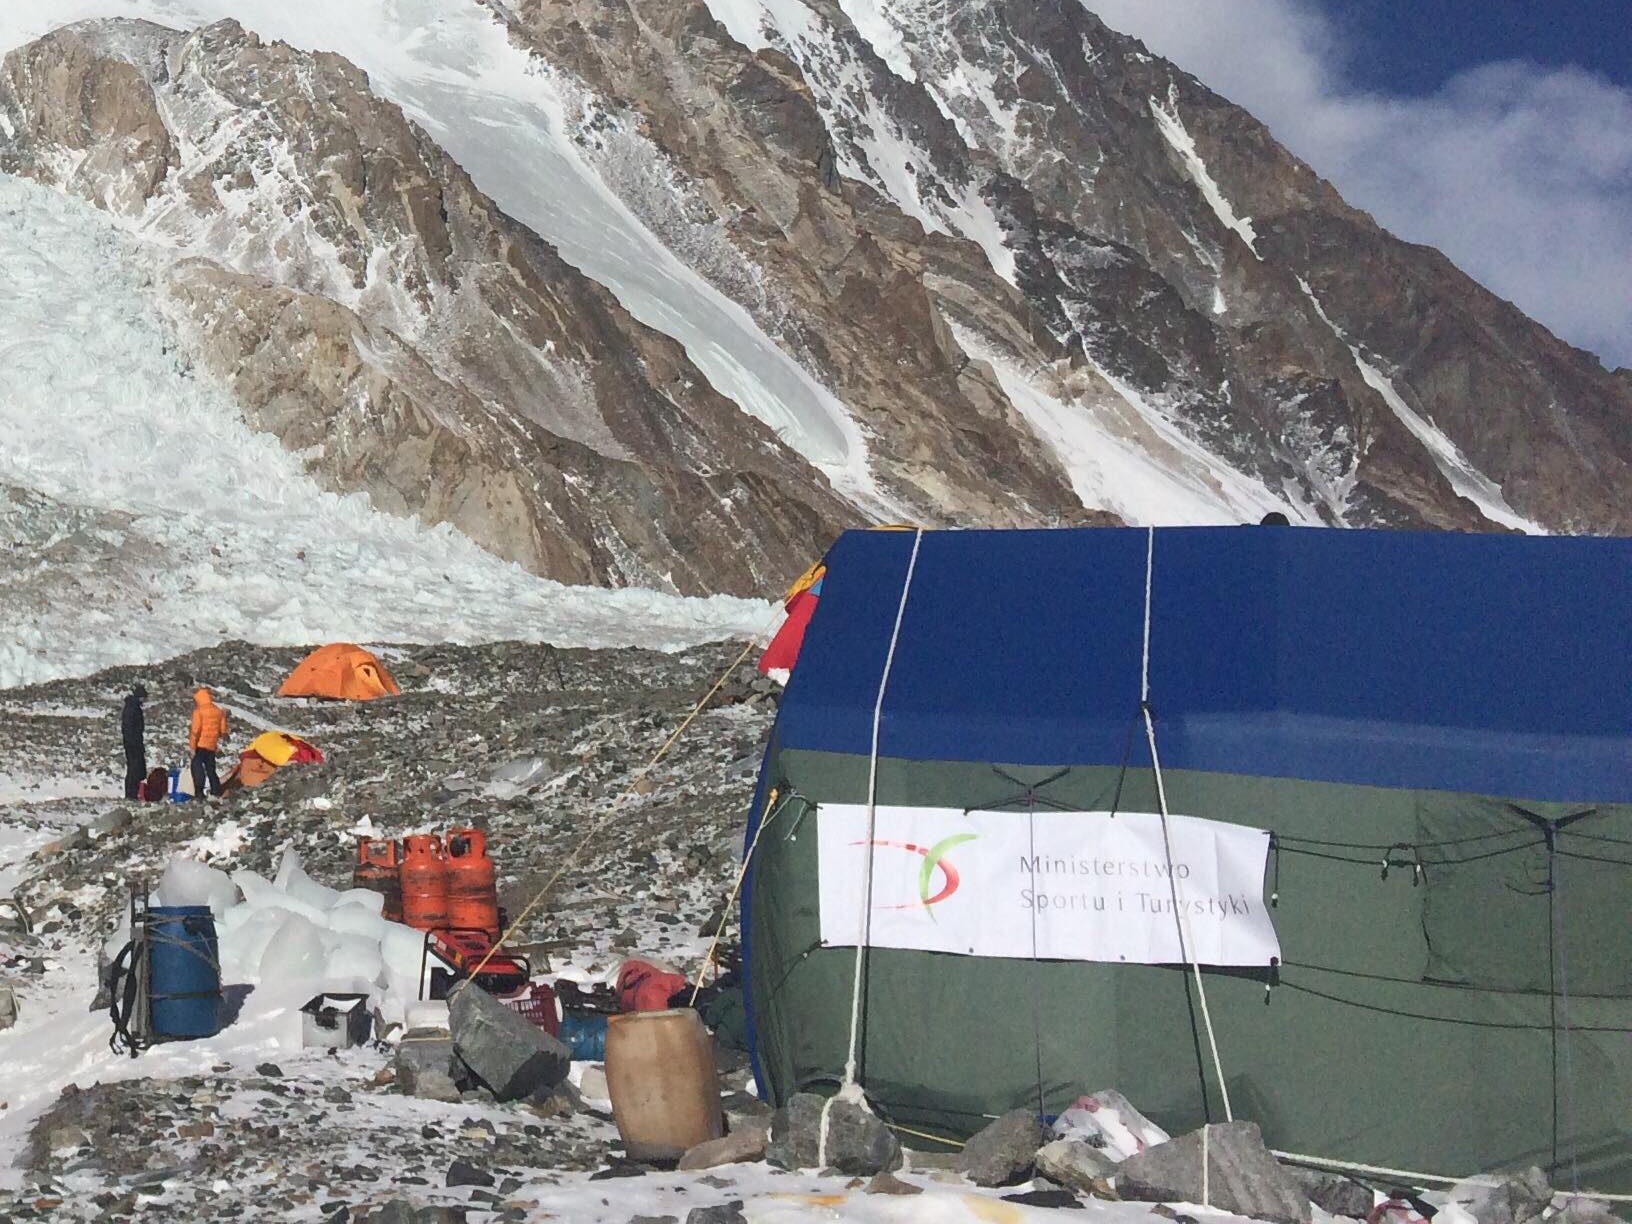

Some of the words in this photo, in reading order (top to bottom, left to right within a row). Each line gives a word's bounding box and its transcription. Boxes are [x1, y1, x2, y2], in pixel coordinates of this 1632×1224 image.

[1020, 856, 1190, 879] Ministerstwo
[1020, 888, 1105, 913] Sportu
[1118, 891, 1124, 911] i
[1136, 892, 1250, 920] Turystyki
